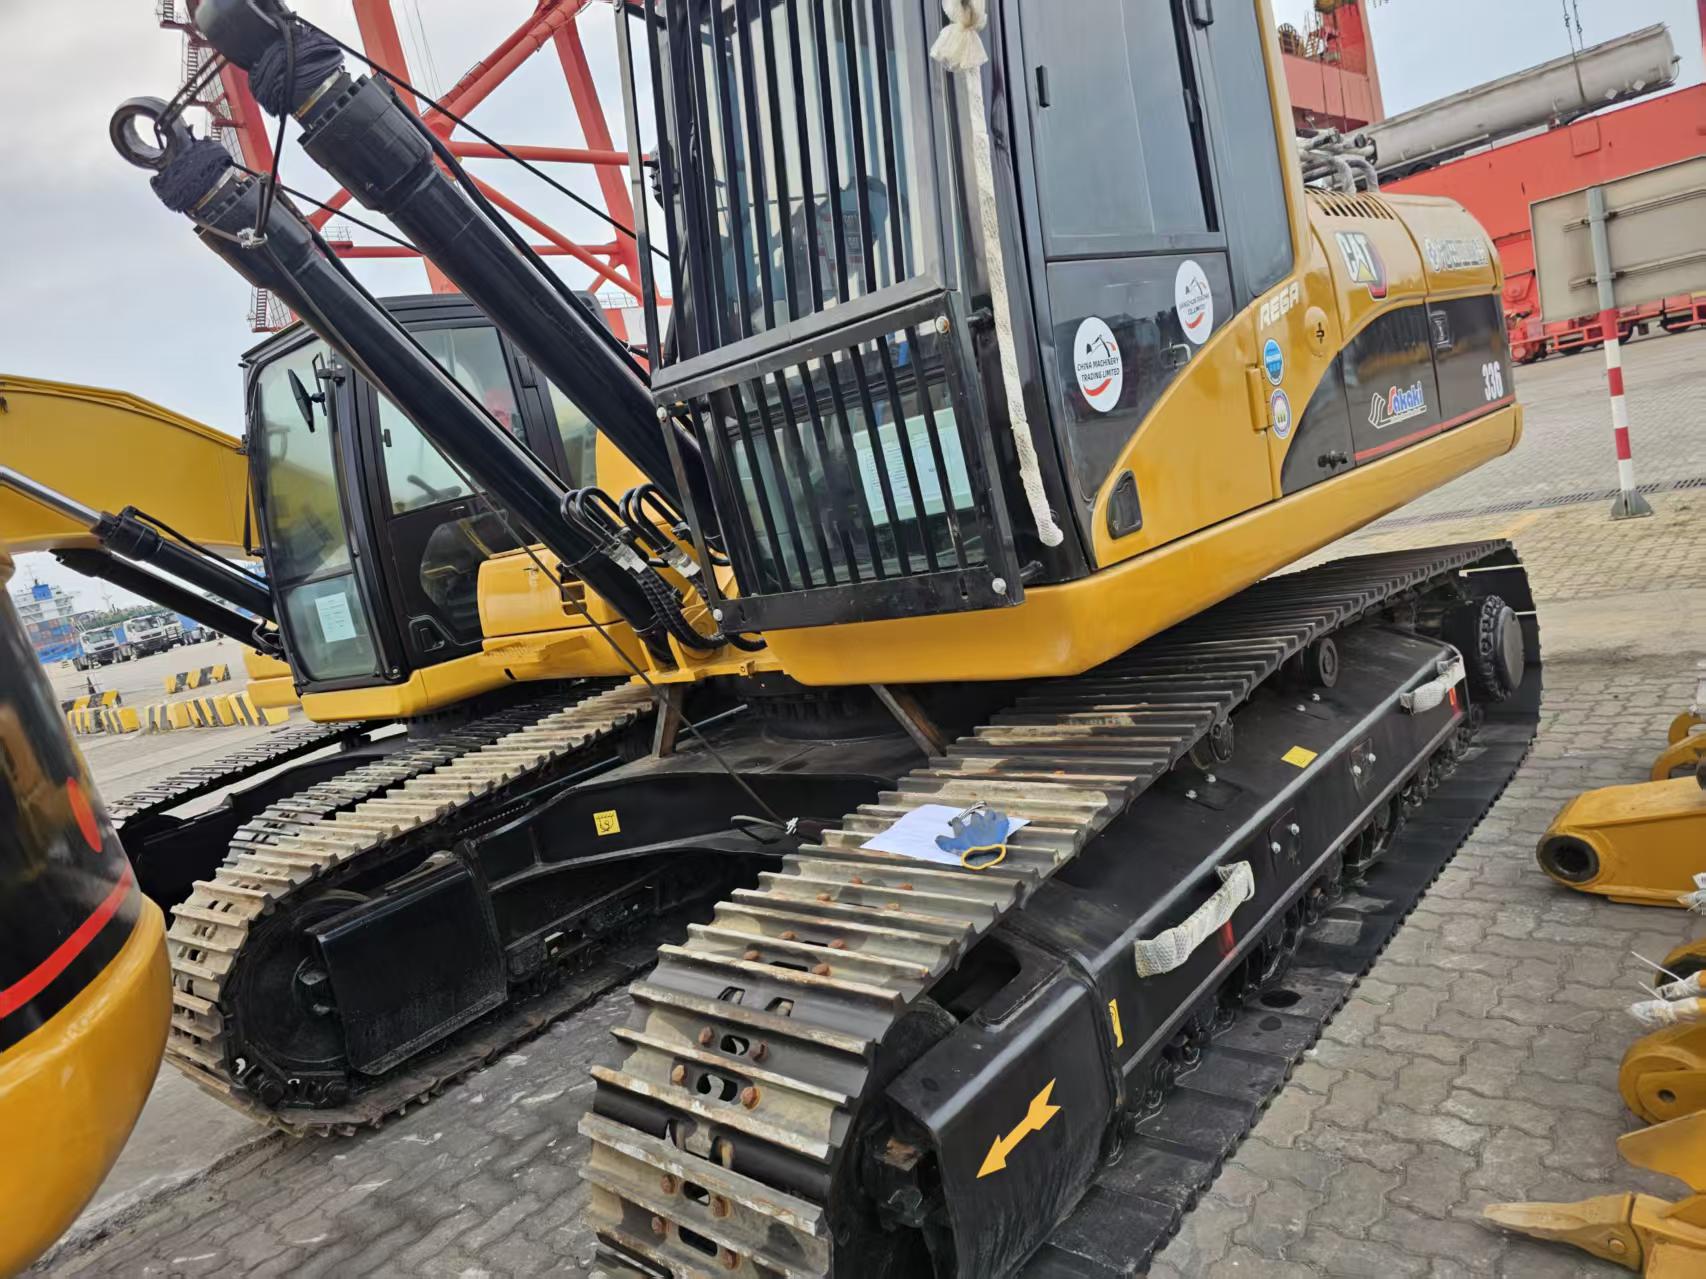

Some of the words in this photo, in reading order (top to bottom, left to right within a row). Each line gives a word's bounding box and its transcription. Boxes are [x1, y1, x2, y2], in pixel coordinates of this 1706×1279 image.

[1335, 231, 1379, 283] CAT
[1077, 361, 1092, 372] CHINA
[1093, 356, 1119, 369] MACHINERY
[1081, 371, 1102, 381] TRADING
[1102, 367, 1120, 378] LIMITED
[1482, 360, 1504, 401] 336
